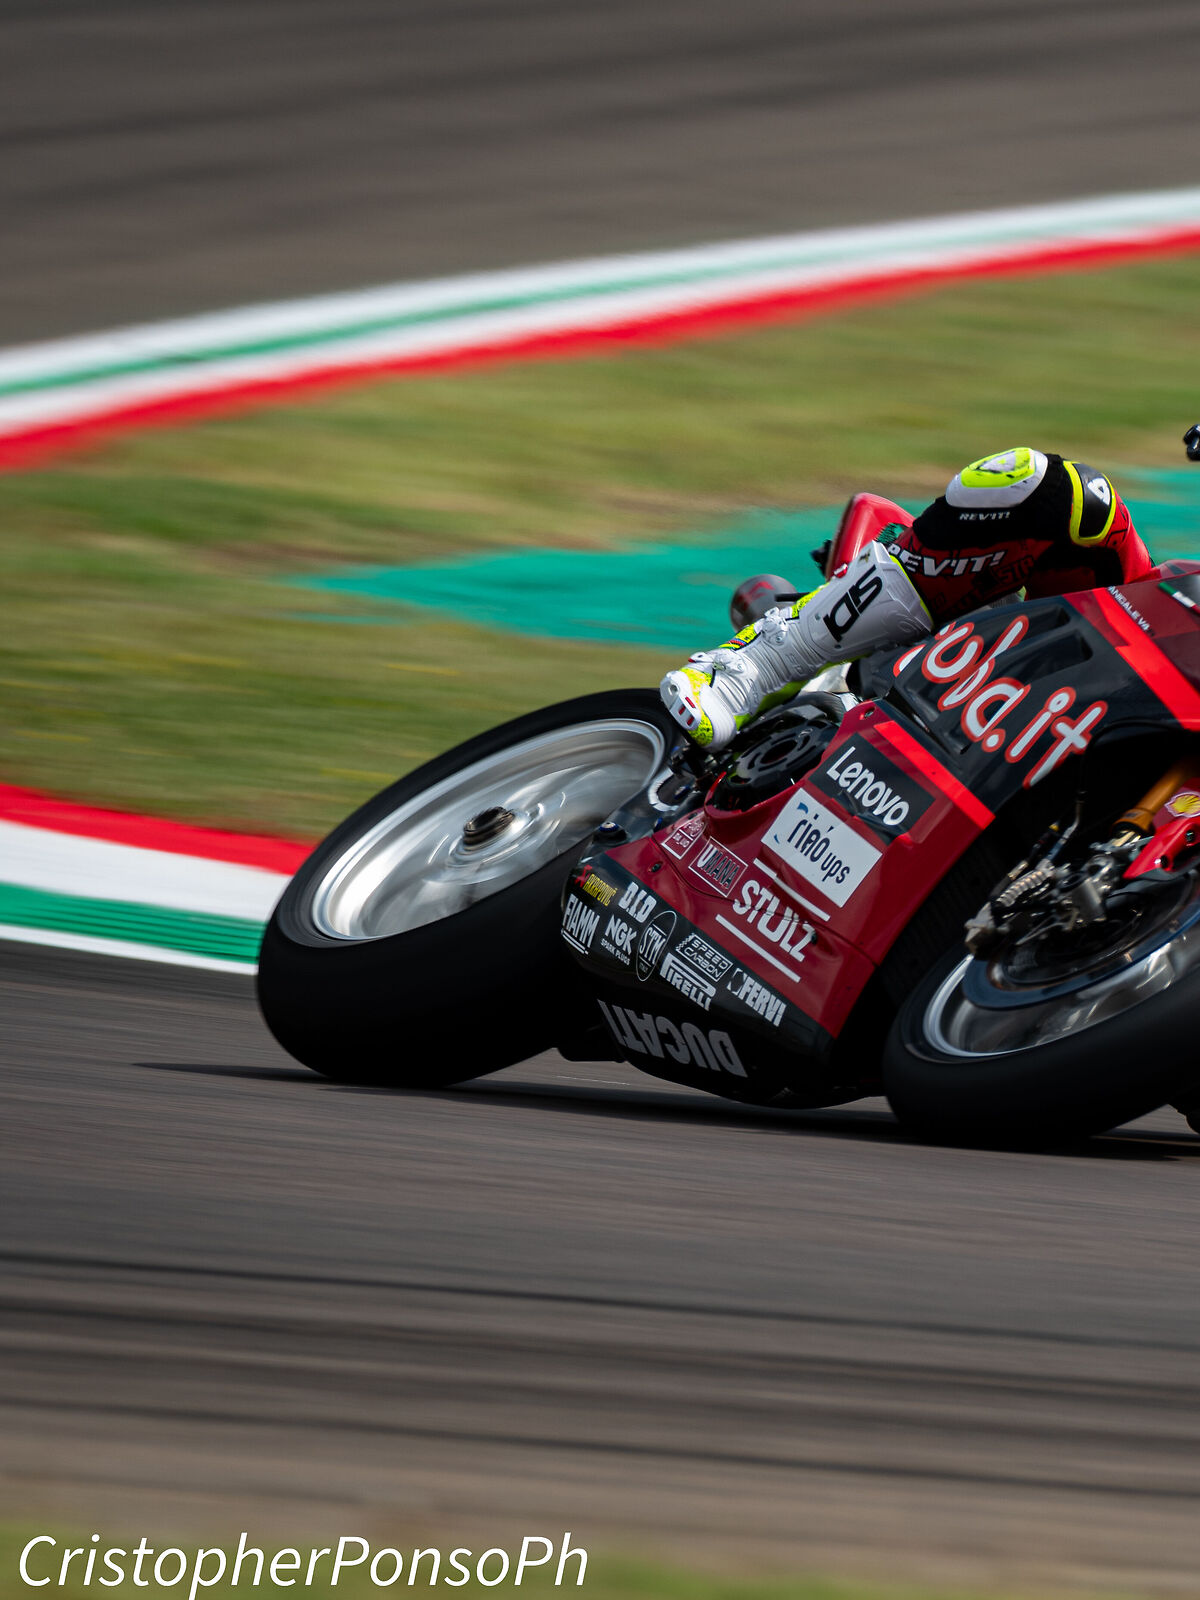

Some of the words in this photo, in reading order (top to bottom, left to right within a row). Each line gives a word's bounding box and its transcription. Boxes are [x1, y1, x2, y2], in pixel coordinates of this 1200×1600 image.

[1107, 586, 1140, 620] ANIGALE
[827, 746, 910, 826] Lenovo
[697, 843, 740, 890] UMANA
[821, 852, 850, 884] ups
[562, 893, 600, 948] FIAMM
[605, 914, 637, 955] NGK
[733, 880, 816, 963] STULZ
[600, 938, 617, 956] SPARK
[614, 949, 631, 966] PLUGS
[640, 926, 667, 965] STM
[684, 948, 722, 979] CARBON
[691, 937, 729, 970] SPEED
[659, 952, 717, 1011] PIRELLI
[736, 974, 787, 1027] FERVI
[597, 998, 748, 1078] DUCATI
